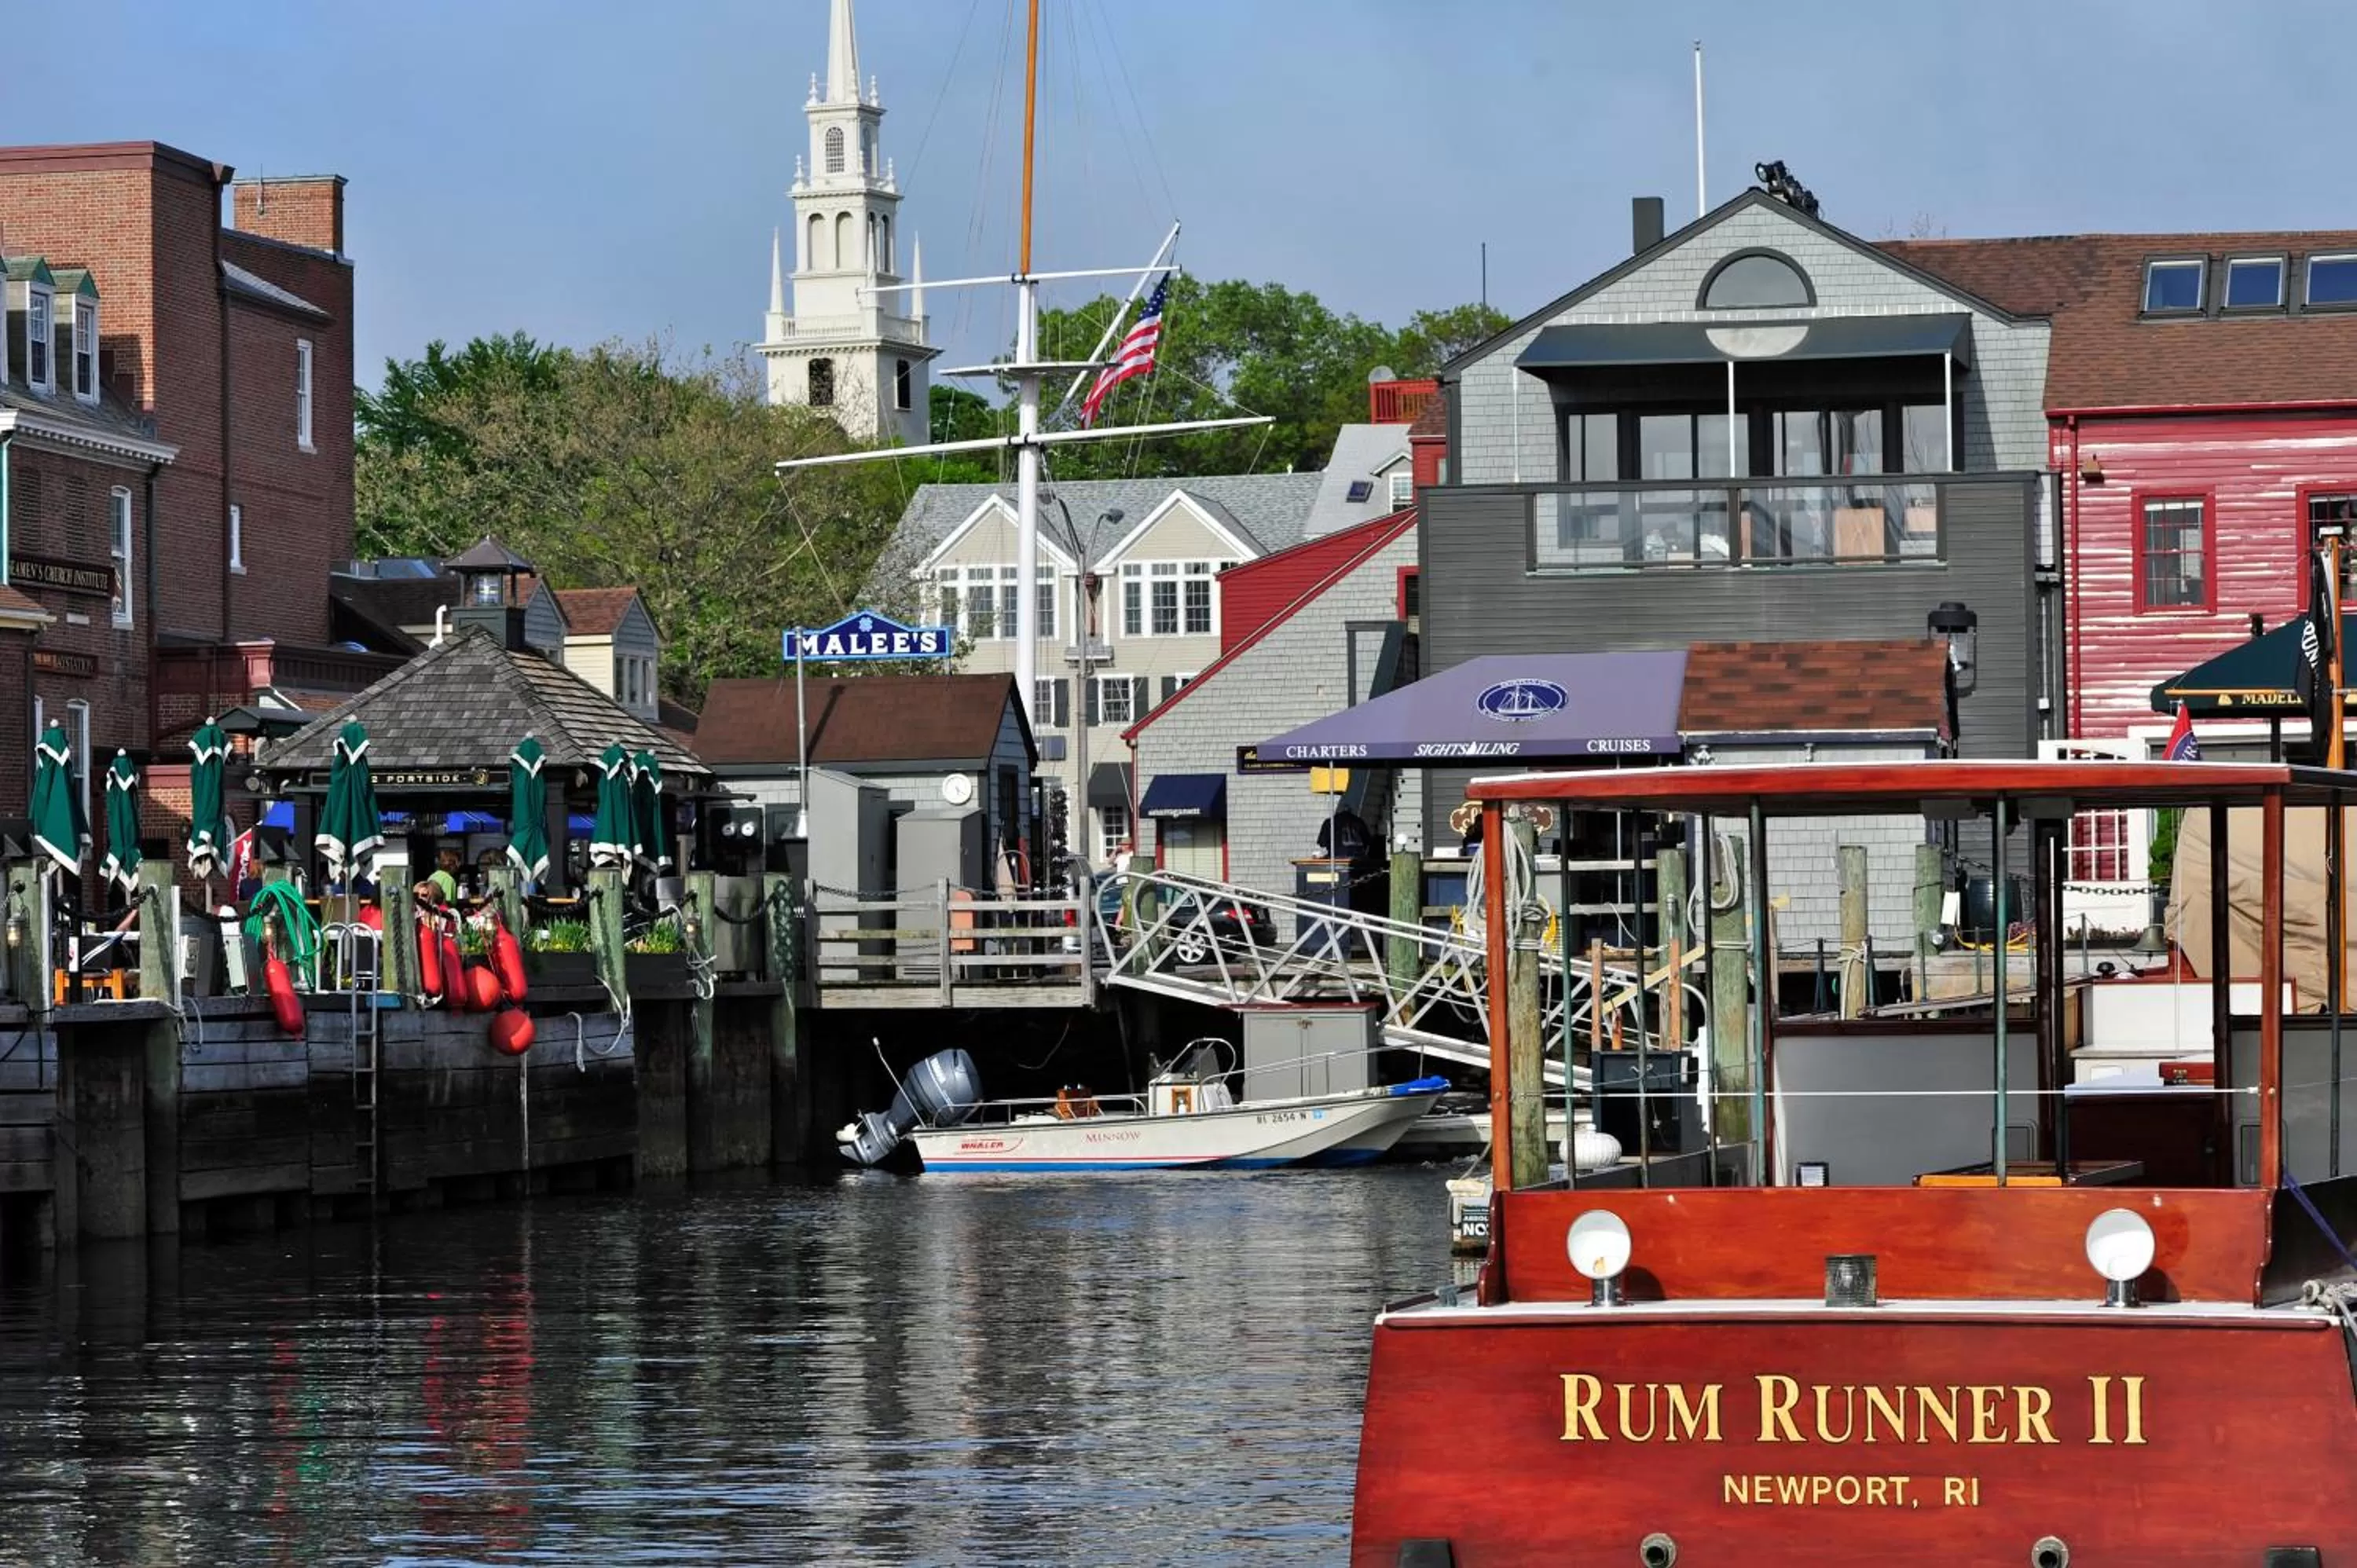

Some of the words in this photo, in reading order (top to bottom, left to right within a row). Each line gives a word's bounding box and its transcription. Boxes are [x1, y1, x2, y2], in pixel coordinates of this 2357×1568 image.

[9, 559, 42, 581] EAMEN'S
[44, 566, 72, 584] CHURCH
[73, 570, 108, 590] INSTITUTE
[1285, 744, 1368, 759] CHARTERS
[1586, 738, 1651, 753] CRUISES
[387, 774, 460, 784] PORTSIDE
[960, 1141, 1004, 1150] WHALER
[1559, 1373, 1724, 1443] RUM
[1754, 1374, 2061, 1445] RUNNER
[2086, 1375, 2148, 1445] II
[1722, 1474, 1919, 1509] NEWPORT,
[1944, 1474, 1980, 1506] RI
